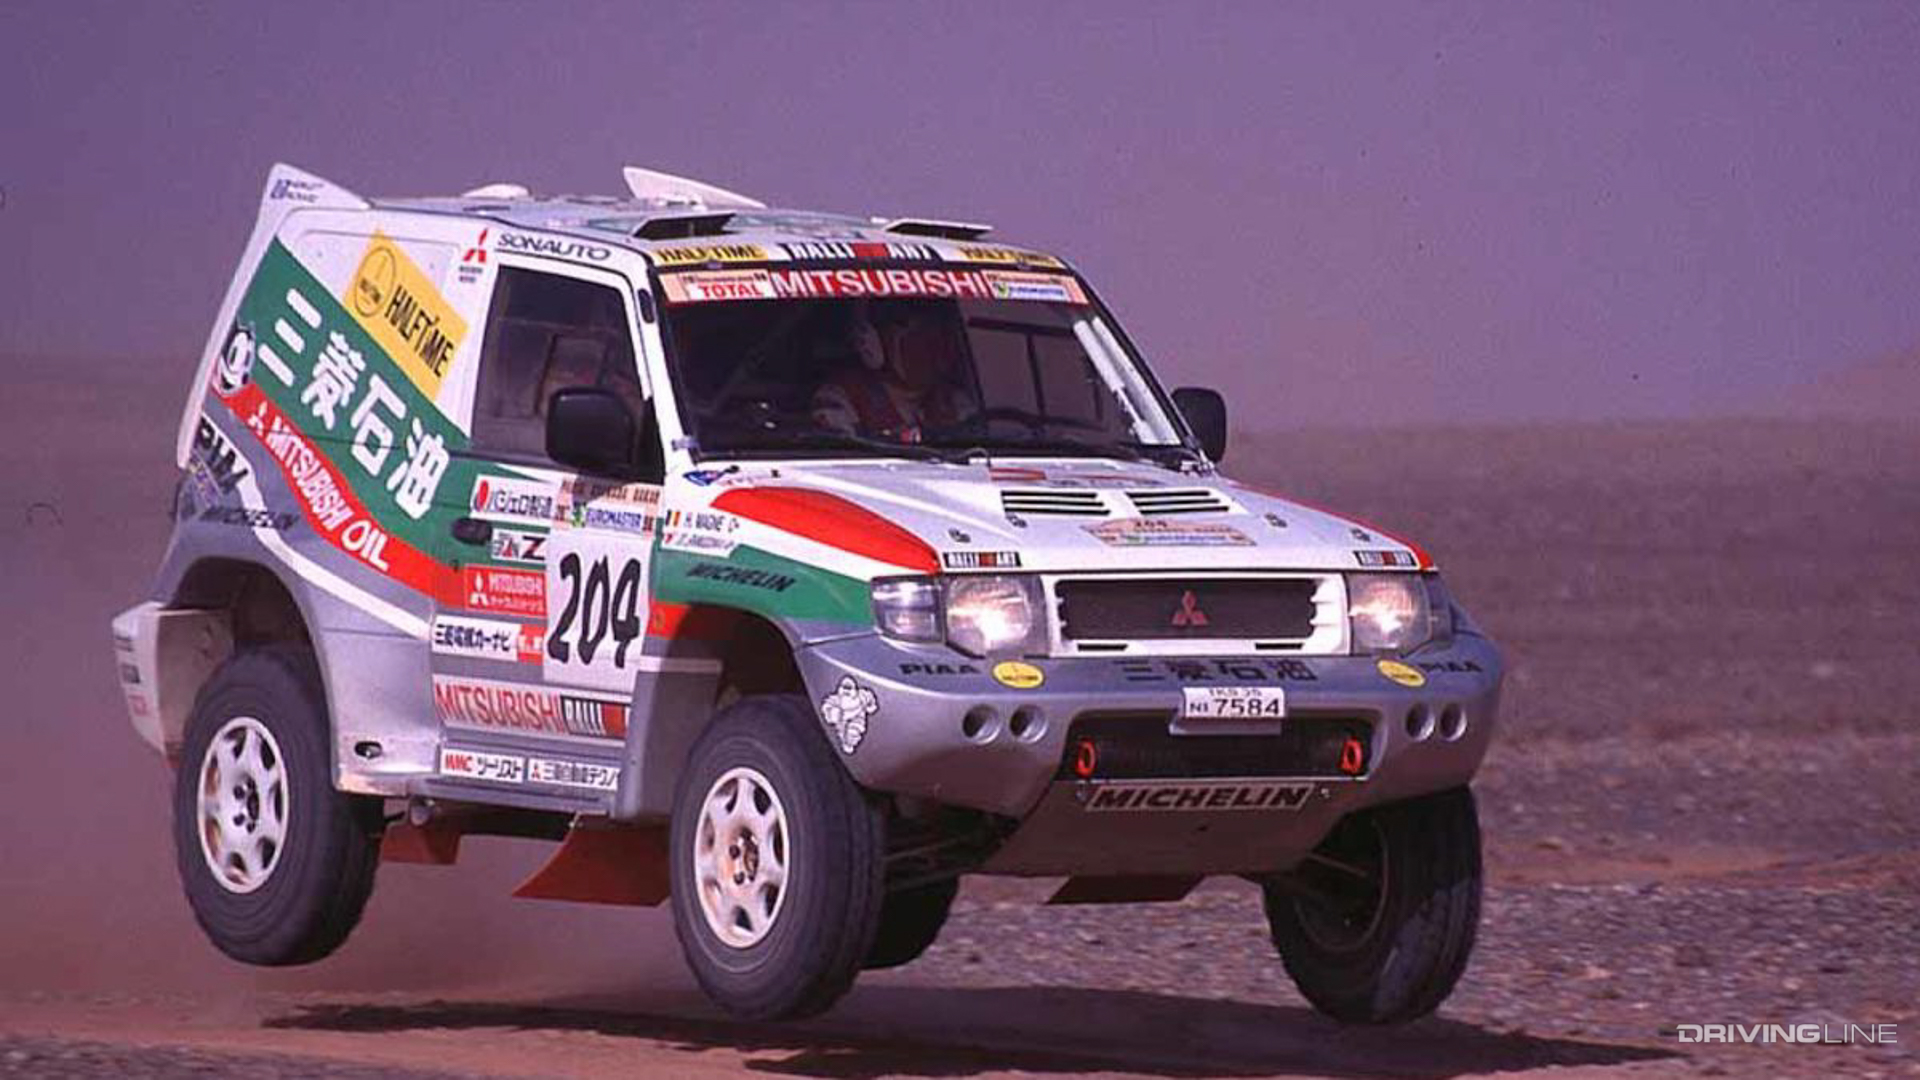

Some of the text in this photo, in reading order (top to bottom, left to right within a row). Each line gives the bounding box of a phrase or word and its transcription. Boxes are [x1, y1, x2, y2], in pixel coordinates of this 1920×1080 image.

[498, 232, 612, 262] SONAUTO
[698, 282, 763, 298] TOTAL
[770, 268, 991, 299] MITSUBISHI
[257, 287, 452, 522] 三菱石油
[265, 416, 390, 572] MITSUBISHI OIL
[687, 562, 797, 592] MICHELIN
[548, 552, 641, 669] 204
[899, 662, 982, 676] PIAA
[1120, 657, 1318, 682] 三菱石油
[435, 683, 567, 735] MITSUBISHI
[1214, 698, 1280, 716] 7584
[1092, 786, 1311, 809] MICHELIN
